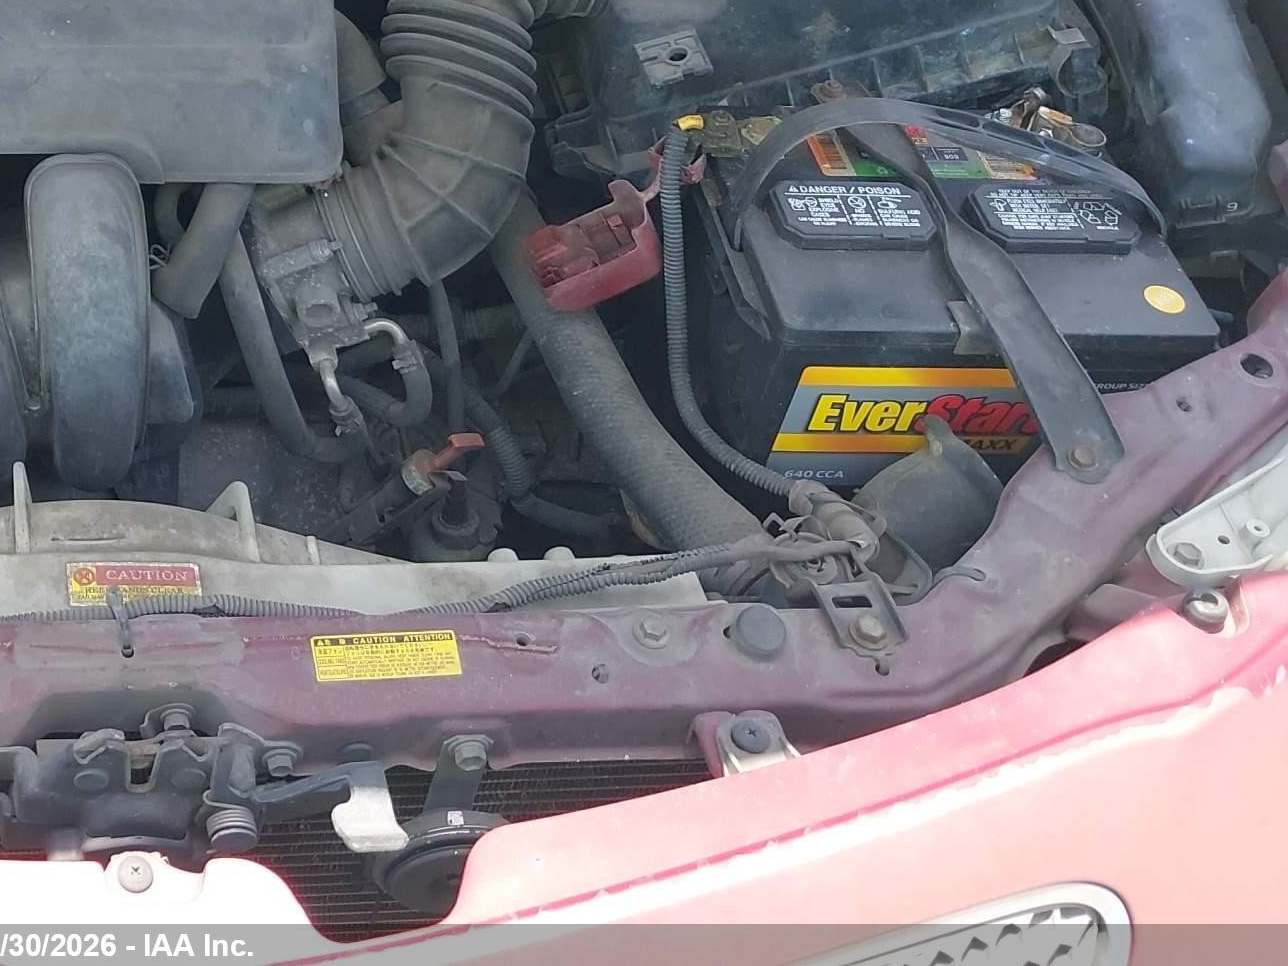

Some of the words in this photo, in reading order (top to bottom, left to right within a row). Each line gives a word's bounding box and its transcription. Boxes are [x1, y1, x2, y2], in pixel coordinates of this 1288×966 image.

[799, 185, 847, 194] DANGER
[857, 186, 902, 195] POISON
[784, 469, 814, 478] 640
[815, 470, 844, 479] CCA
[105, 569, 188, 581] CAUTION
[122, 586, 150, 594] ANDS
[352, 636, 397, 644] CAUTION
[403, 633, 452, 643] ATTENTION
